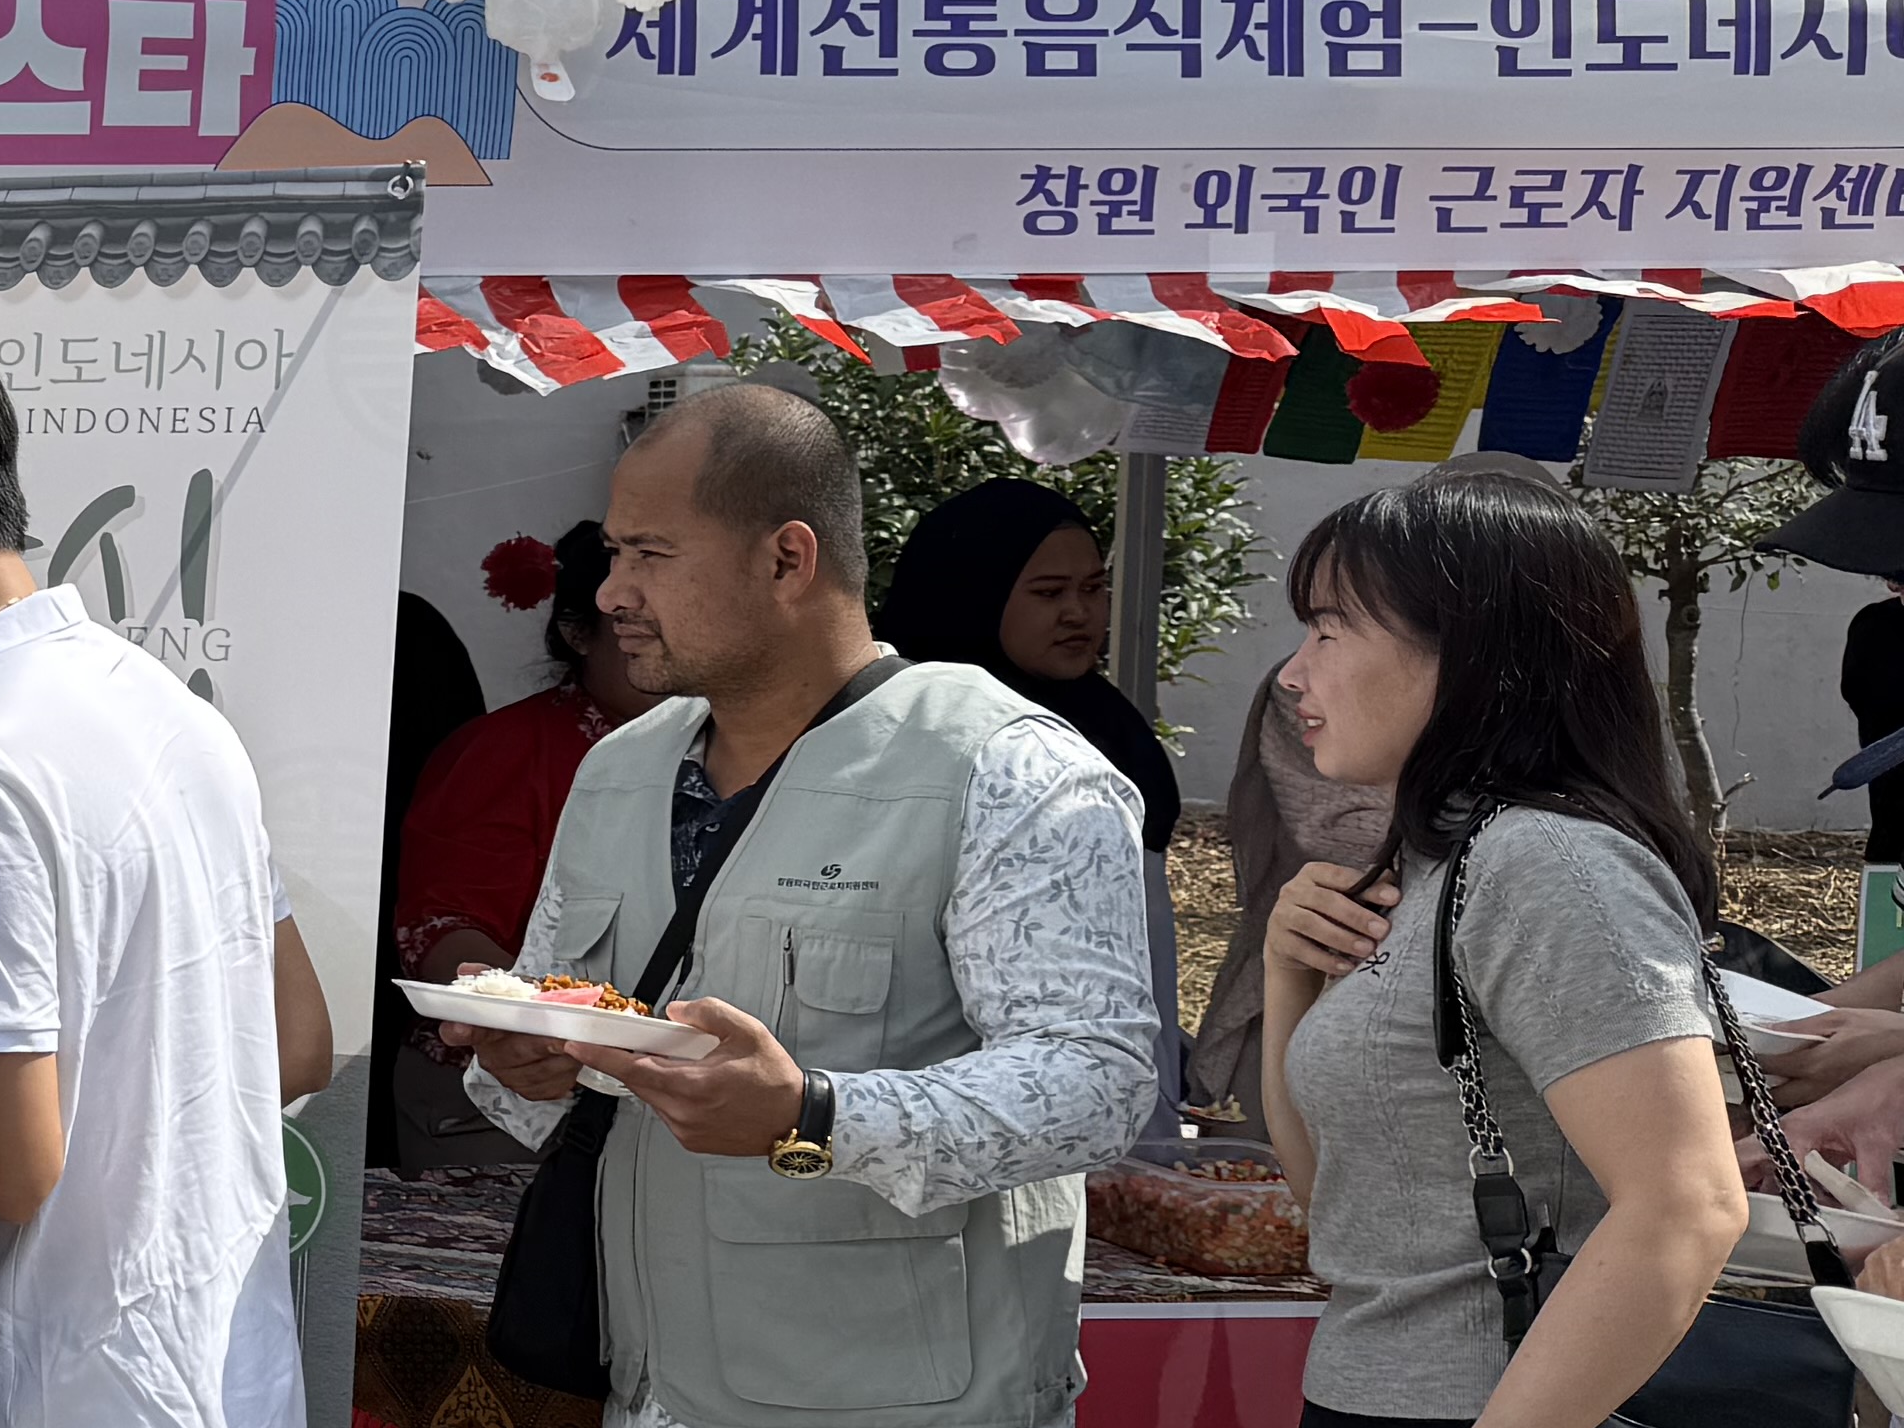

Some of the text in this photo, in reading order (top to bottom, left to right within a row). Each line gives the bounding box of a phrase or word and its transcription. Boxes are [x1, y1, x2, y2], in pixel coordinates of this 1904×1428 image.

[1018, 162, 1160, 238] 창원
[1184, 163, 1398, 236] 외국인
[1429, 163, 1645, 233] 근로자
[25, 405, 268, 435] INDONESIA
